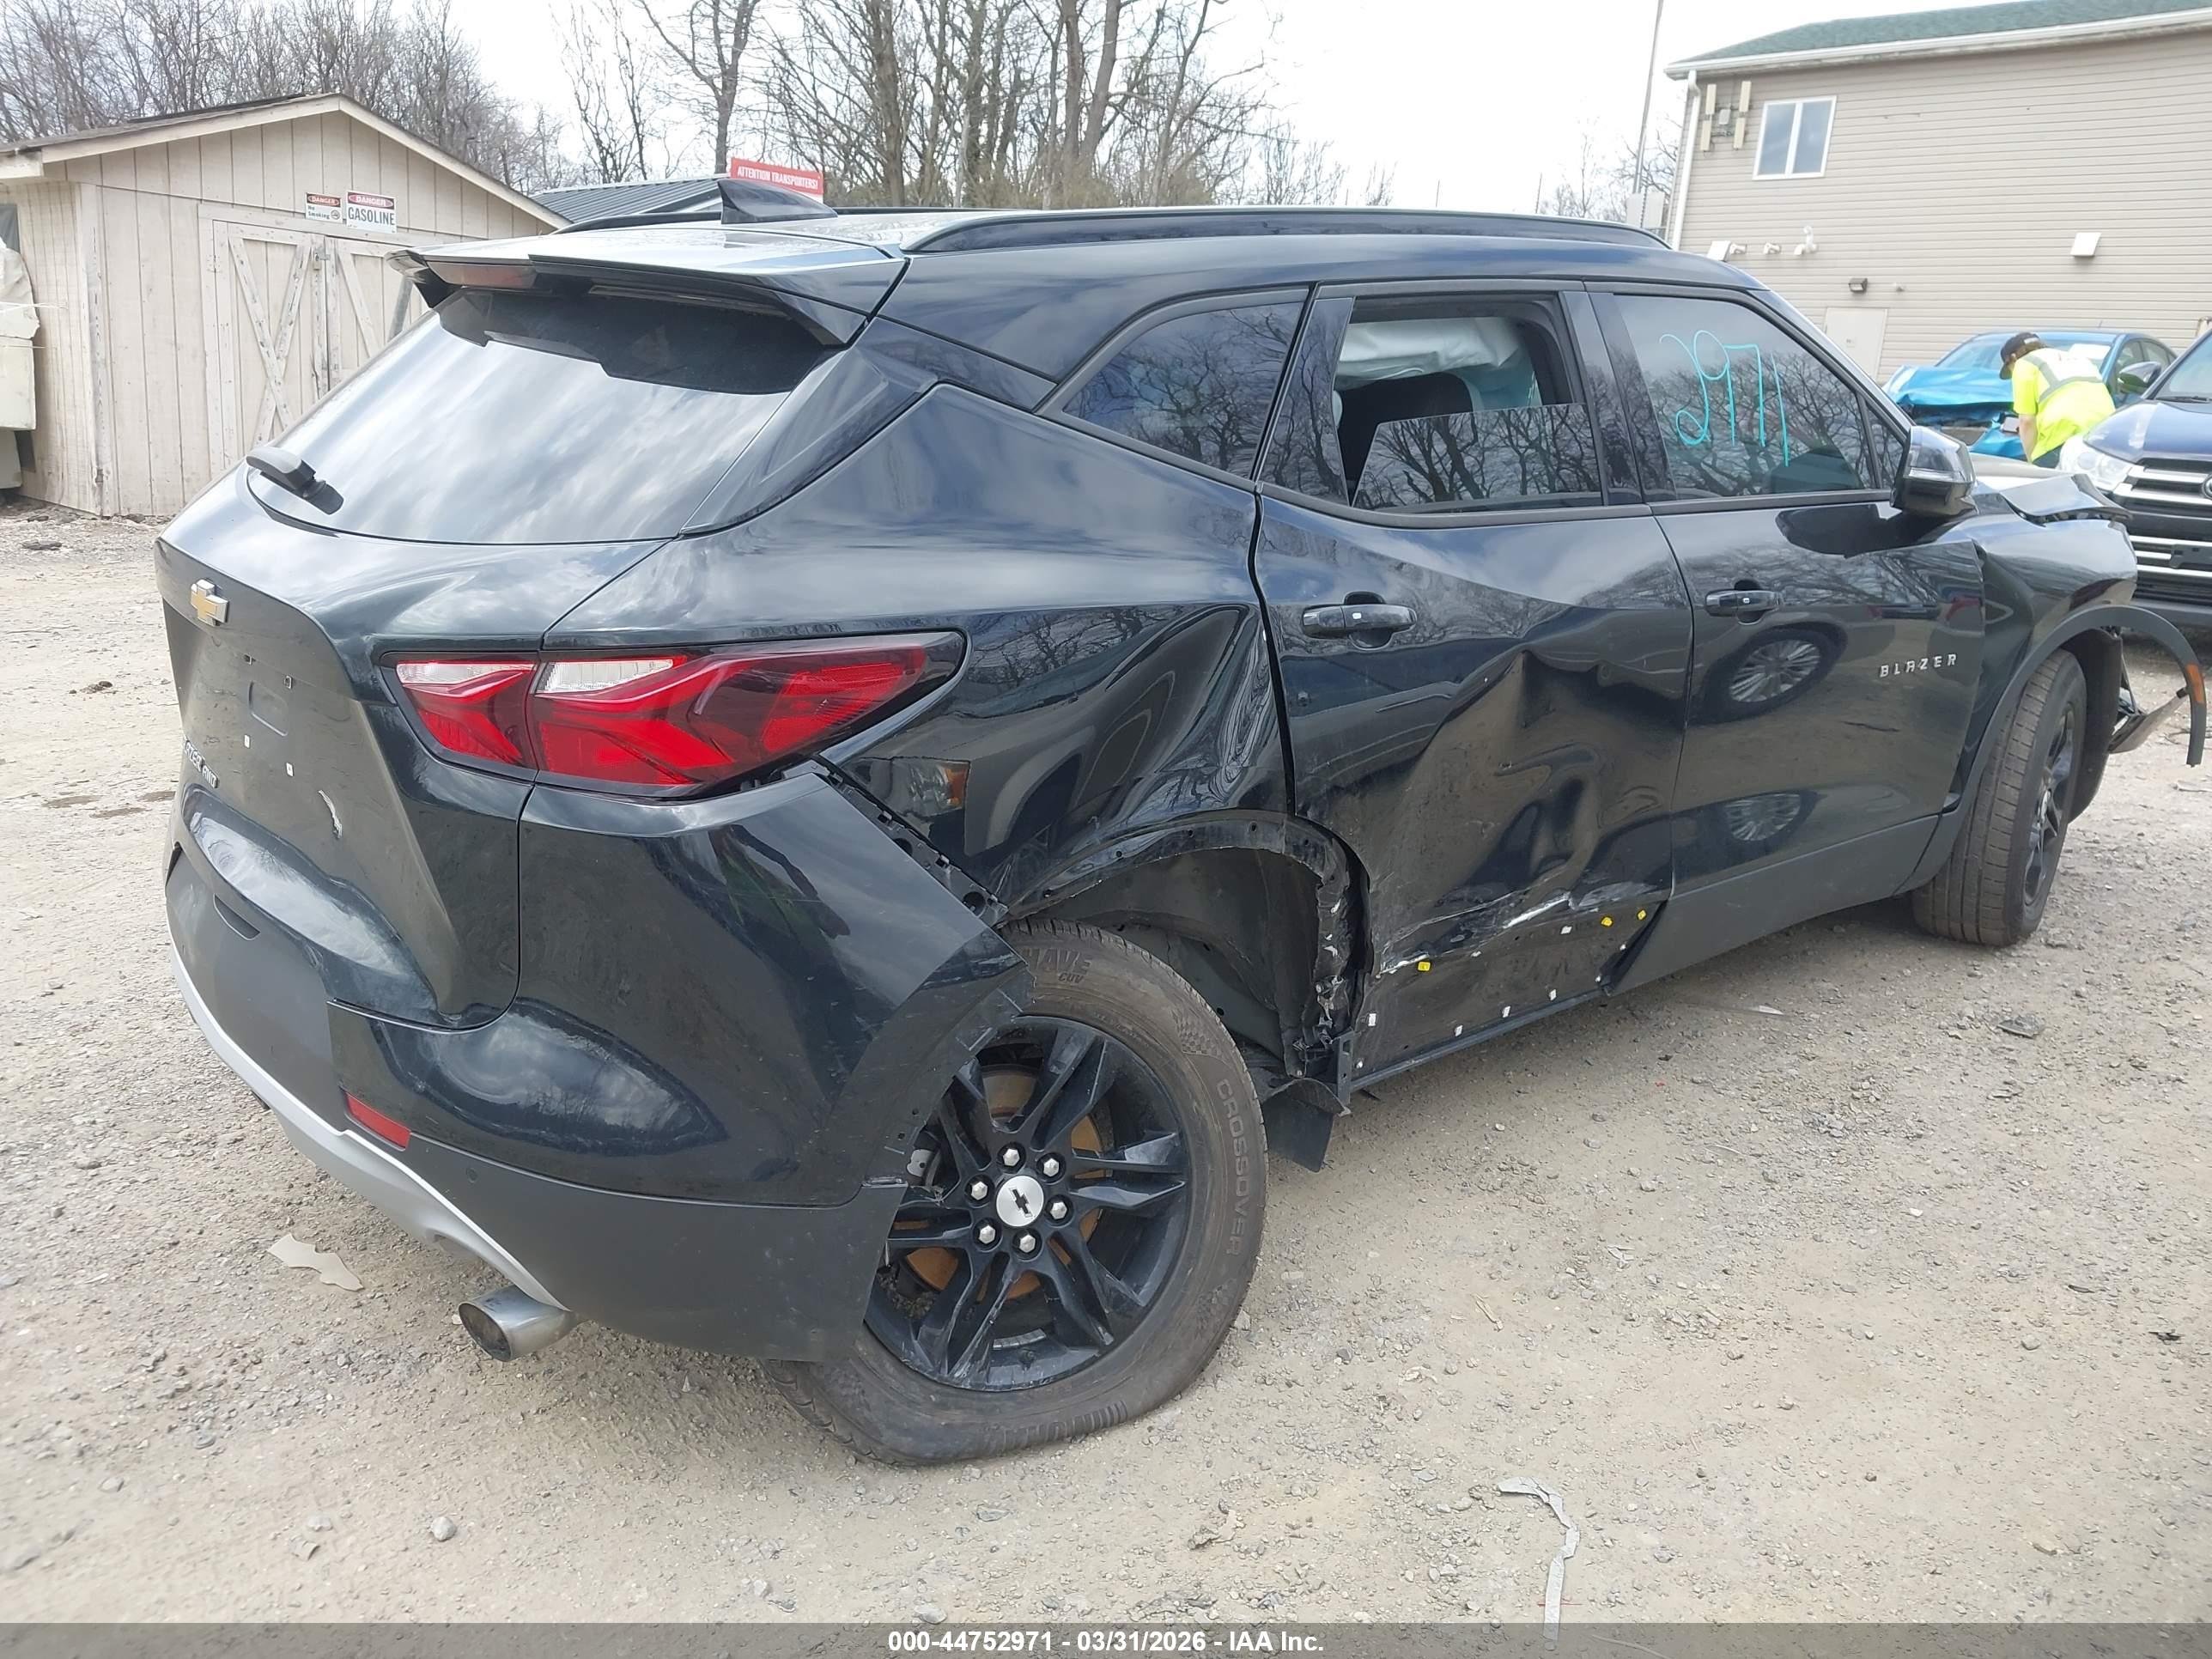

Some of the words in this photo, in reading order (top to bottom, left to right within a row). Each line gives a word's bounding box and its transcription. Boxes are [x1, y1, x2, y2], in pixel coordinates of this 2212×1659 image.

[737, 167, 770, 180] ATTENTION
[312, 196, 336, 204] DANGER
[356, 195, 386, 206] DANGER
[307, 210, 330, 220] Smoking
[348, 207, 395, 225] GASOLINE
[1880, 653, 1958, 678] BLAZER
[203, 764, 217, 788] AWD
[1058, 971, 1085, 984] CUV
[1216, 1078, 1249, 1256] CROSSOVER
